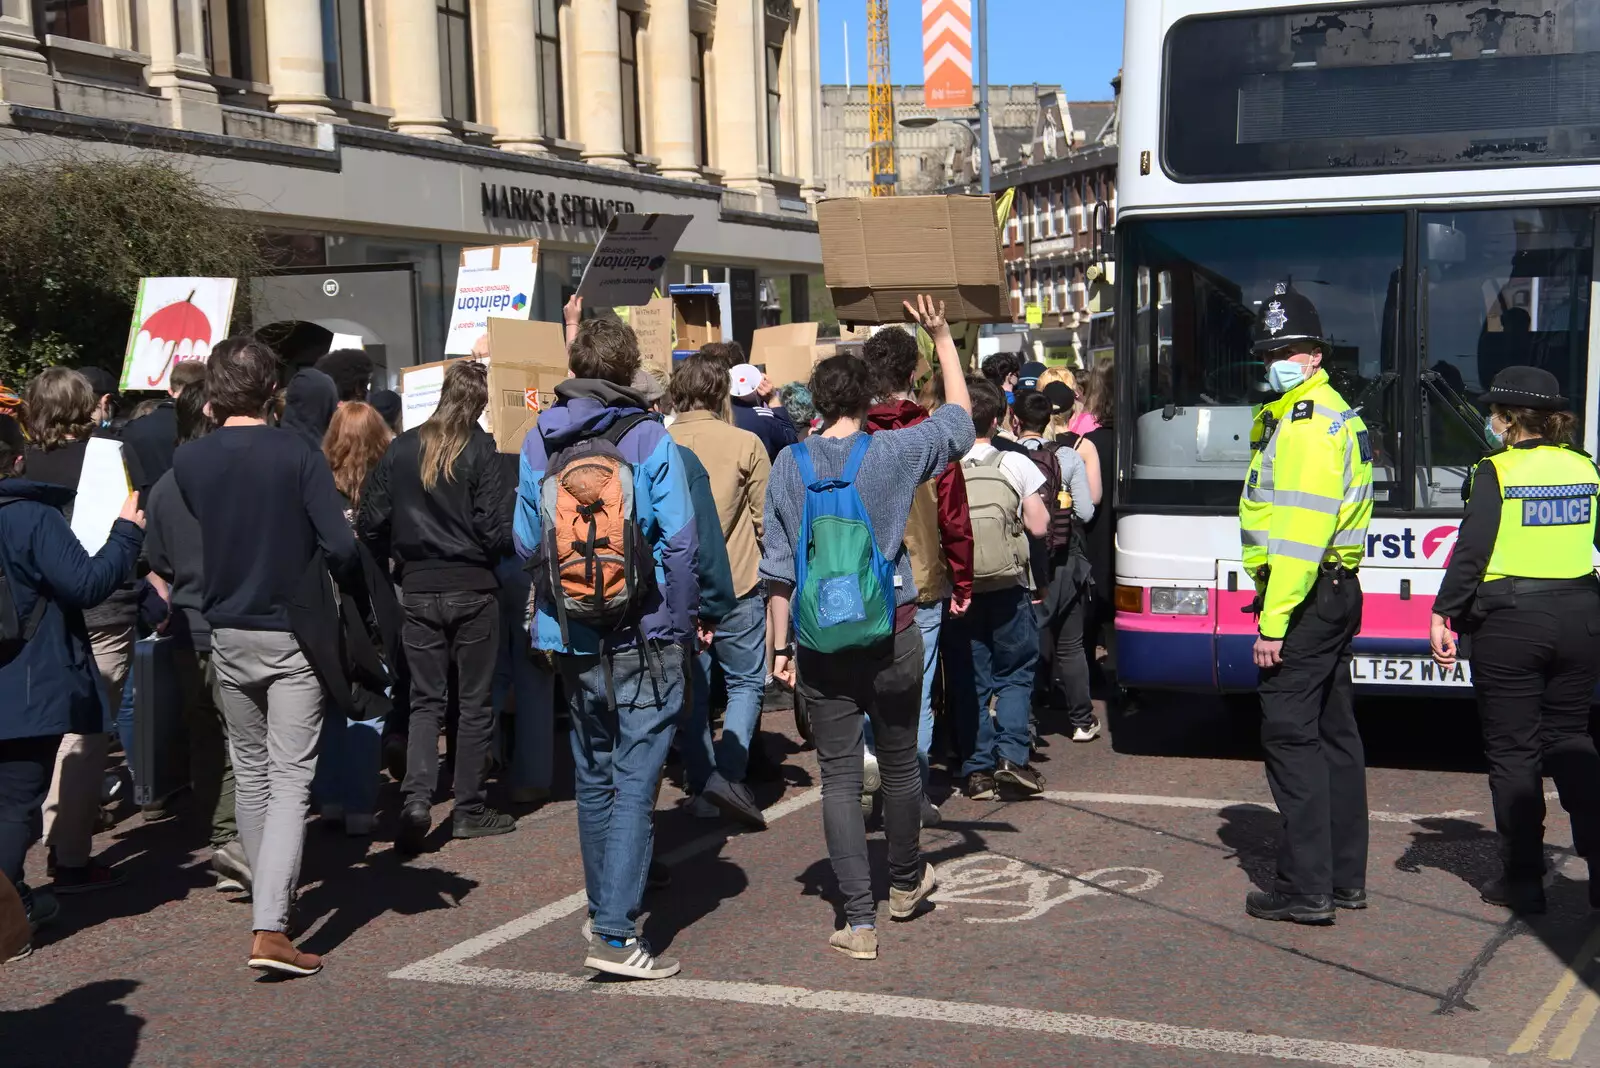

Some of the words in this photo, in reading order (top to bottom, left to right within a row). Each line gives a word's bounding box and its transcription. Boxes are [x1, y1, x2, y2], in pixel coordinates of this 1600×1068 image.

[480, 182, 544, 222] MARKS
[547, 191, 559, 224] &
[593, 255, 650, 271] dainton
[457, 294, 511, 312] dainton
[1525, 499, 1590, 524] POLICE
[1366, 528, 1416, 559] rst
[1353, 659, 1413, 680] LT52
[1420, 661, 1465, 682] WVA
